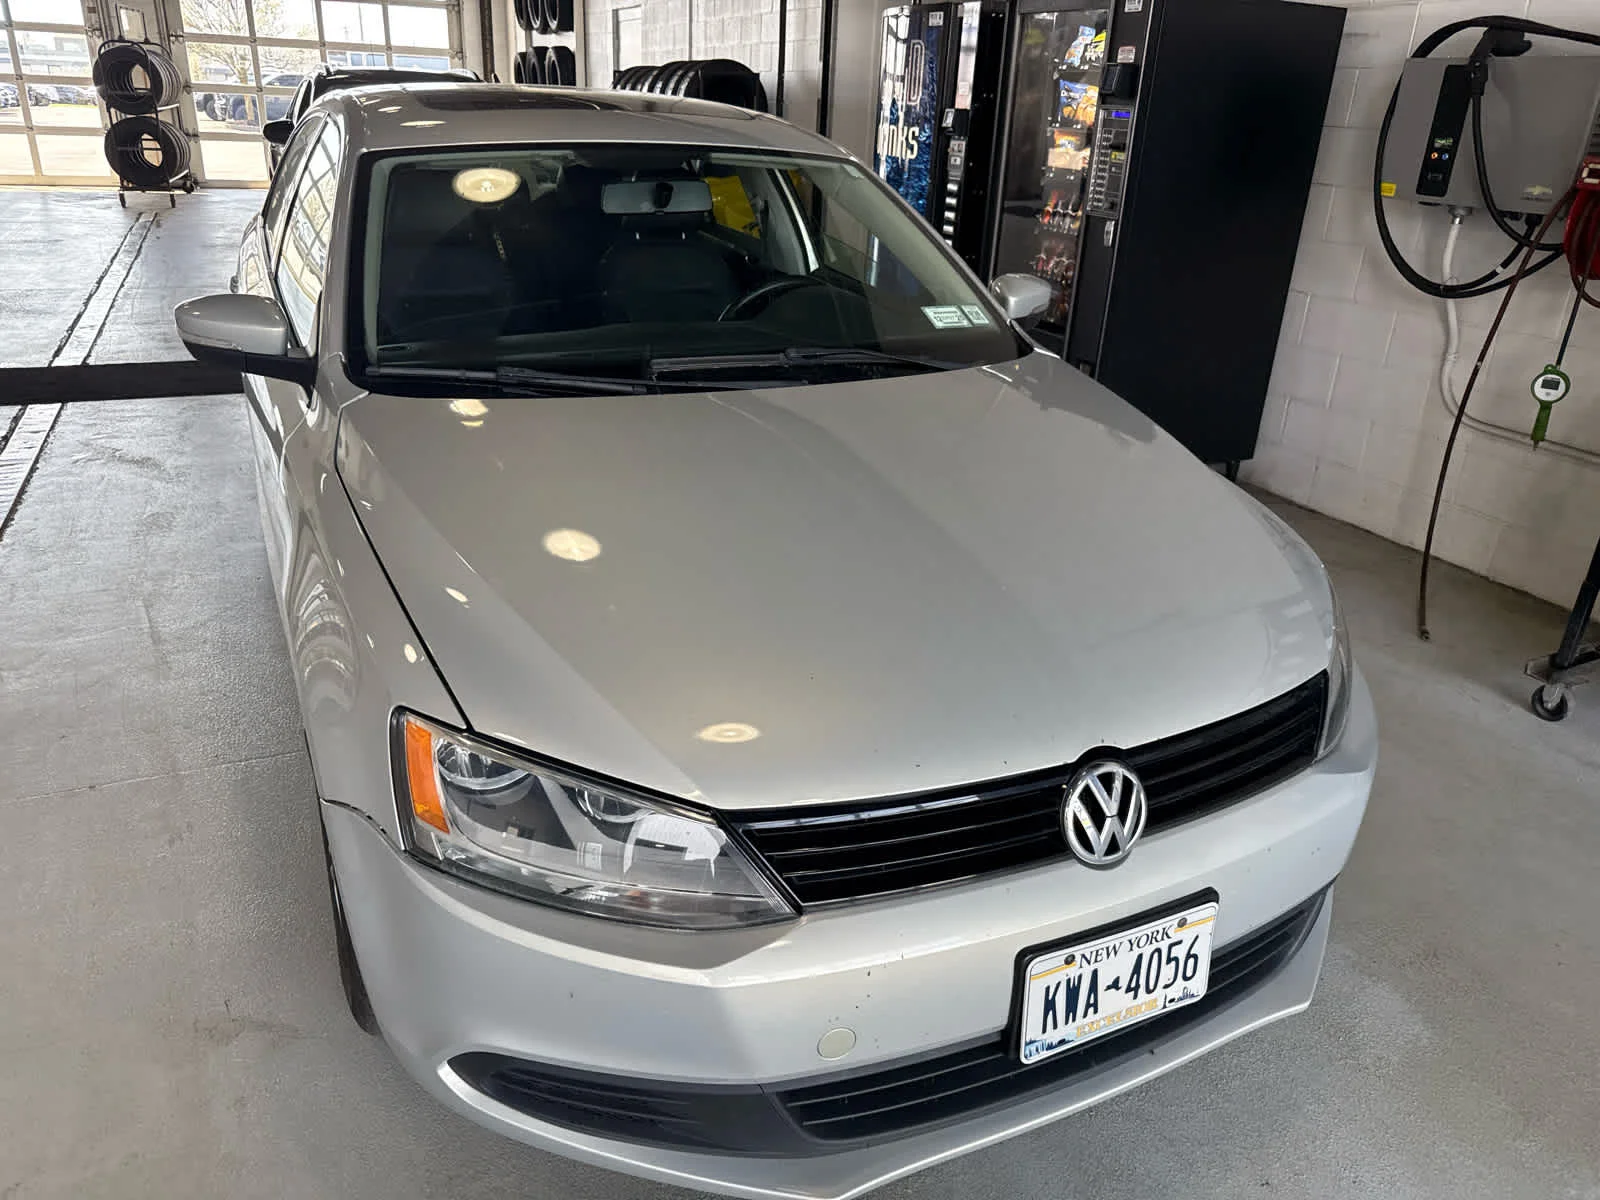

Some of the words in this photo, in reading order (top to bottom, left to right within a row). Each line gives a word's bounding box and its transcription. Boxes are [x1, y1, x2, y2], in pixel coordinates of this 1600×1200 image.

[1079, 943, 1122, 969] NEW
[1127, 924, 1174, 953] YORK
[1041, 968, 1099, 1034] KWA
[1124, 934, 1200, 1001] 4056
[1076, 998, 1158, 1037] EXCELSIOR
